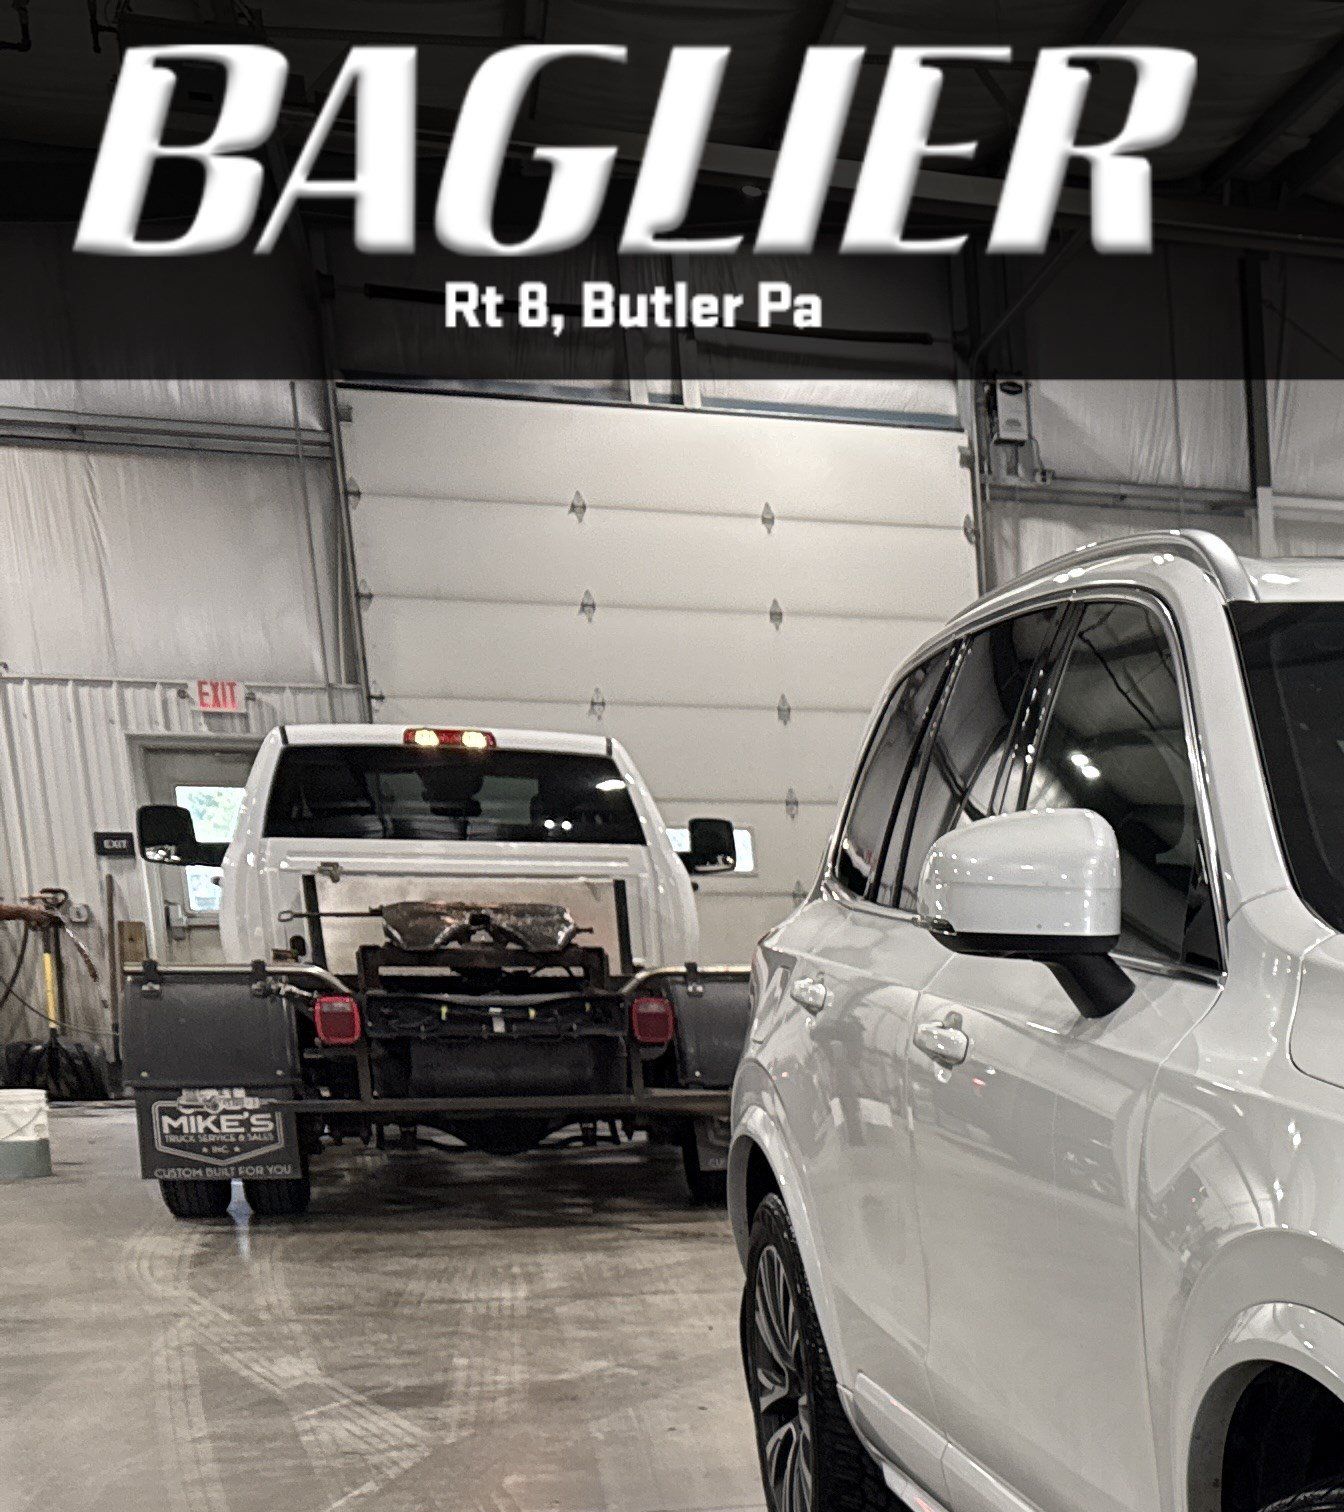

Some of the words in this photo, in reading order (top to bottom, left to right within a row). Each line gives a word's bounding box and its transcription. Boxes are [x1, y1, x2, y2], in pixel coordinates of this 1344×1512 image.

[197, 679, 237, 709] EXIT
[161, 1111, 275, 1134] MIKE'S
[153, 1167, 203, 1180] CUSTOM
[205, 1165, 235, 1178] BUILT
[238, 1164, 264, 1177] FOR
[266, 1163, 292, 1176] YOU
